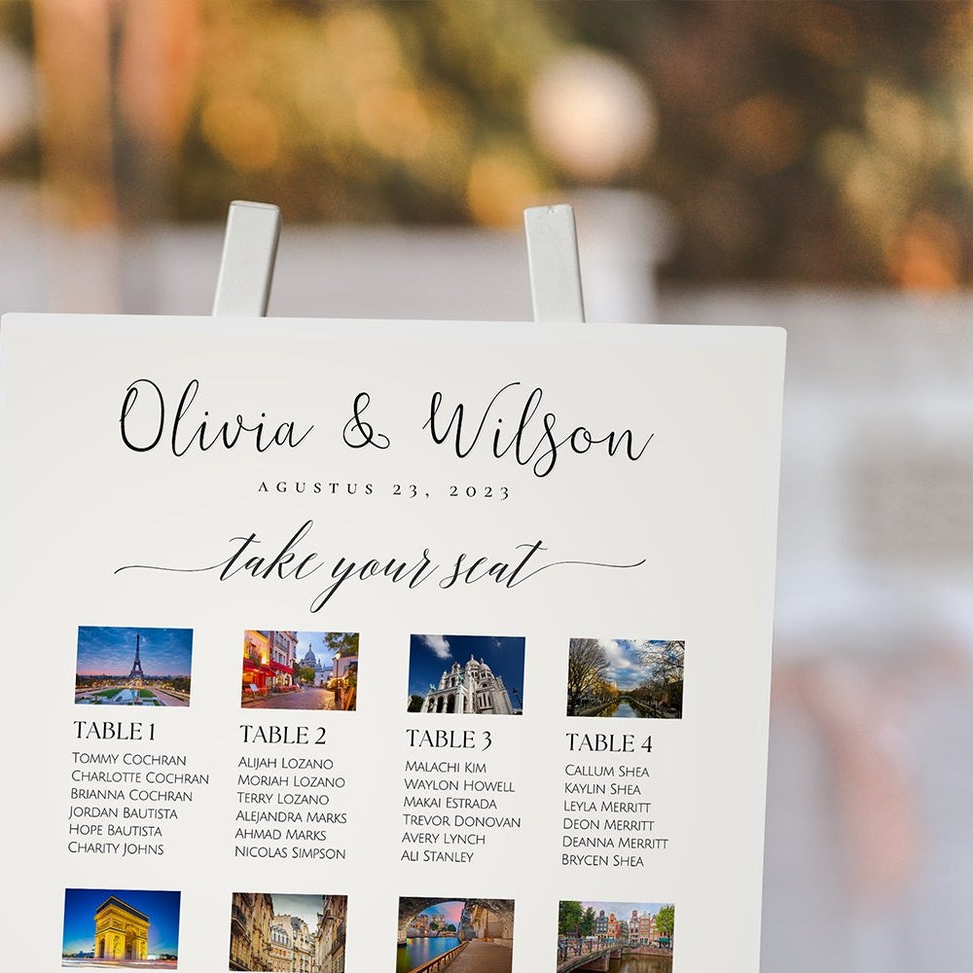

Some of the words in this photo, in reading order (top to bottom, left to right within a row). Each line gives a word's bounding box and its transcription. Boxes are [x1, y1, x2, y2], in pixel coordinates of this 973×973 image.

[118, 378, 315, 458] Olivia
[342, 391, 391, 450] &
[421, 381, 655, 479] Wilson
[257, 480, 374, 496] AGUSTUS
[392, 483, 430, 499] 23,
[449, 485, 509, 502] 2023
[309, 547, 440, 614] your
[74, 721, 142, 740] TABLE
[150, 723, 154, 741] 1
[240, 725, 309, 744] TABLE
[315, 727, 326, 744] 2
[406, 729, 475, 748] TABLE
[482, 731, 492, 751] 3
[566, 733, 634, 752] TABLE
[641, 736, 652, 752] 4
